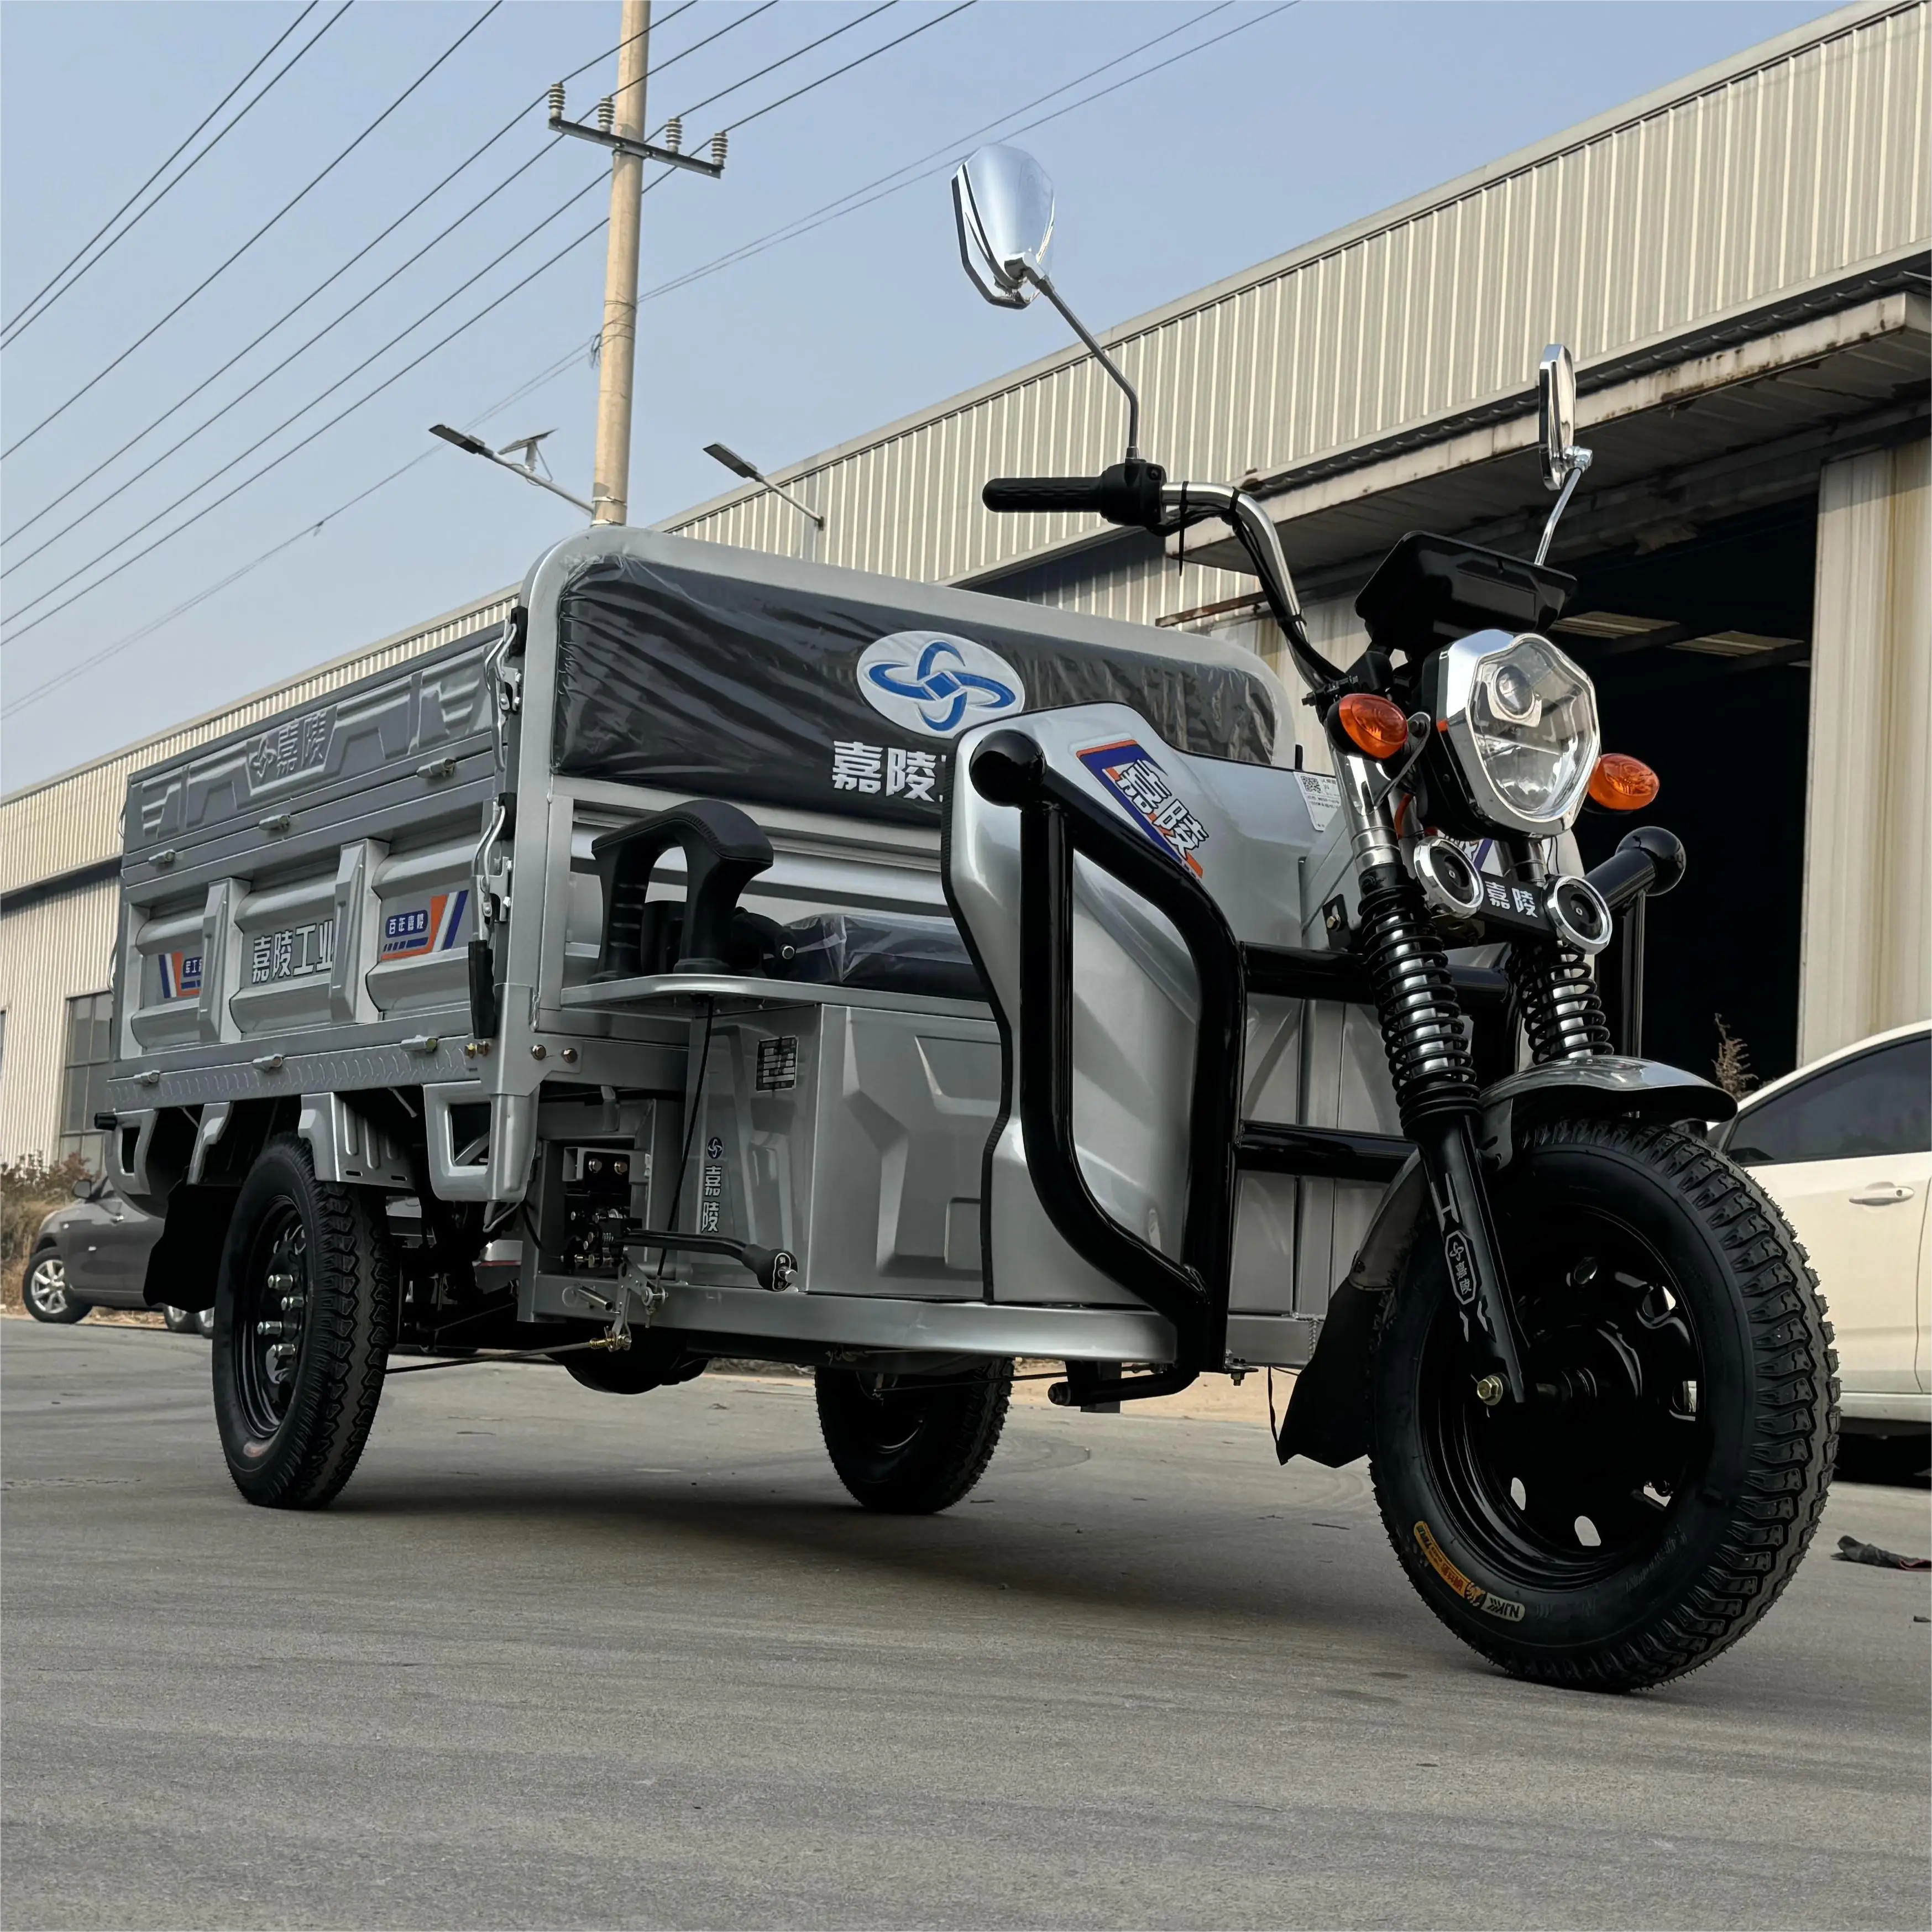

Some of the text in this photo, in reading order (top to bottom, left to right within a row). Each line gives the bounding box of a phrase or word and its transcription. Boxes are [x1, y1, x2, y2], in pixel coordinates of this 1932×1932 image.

[276, 710, 327, 778] 嘉陵
[832, 741, 946, 803] 嘉陵
[1114, 759, 1210, 861] 嘉陵
[1484, 881, 1538, 918] 嘉陵
[252, 919, 334, 984] 嘉陵工业
[701, 1165, 722, 1233] 嘉陵
